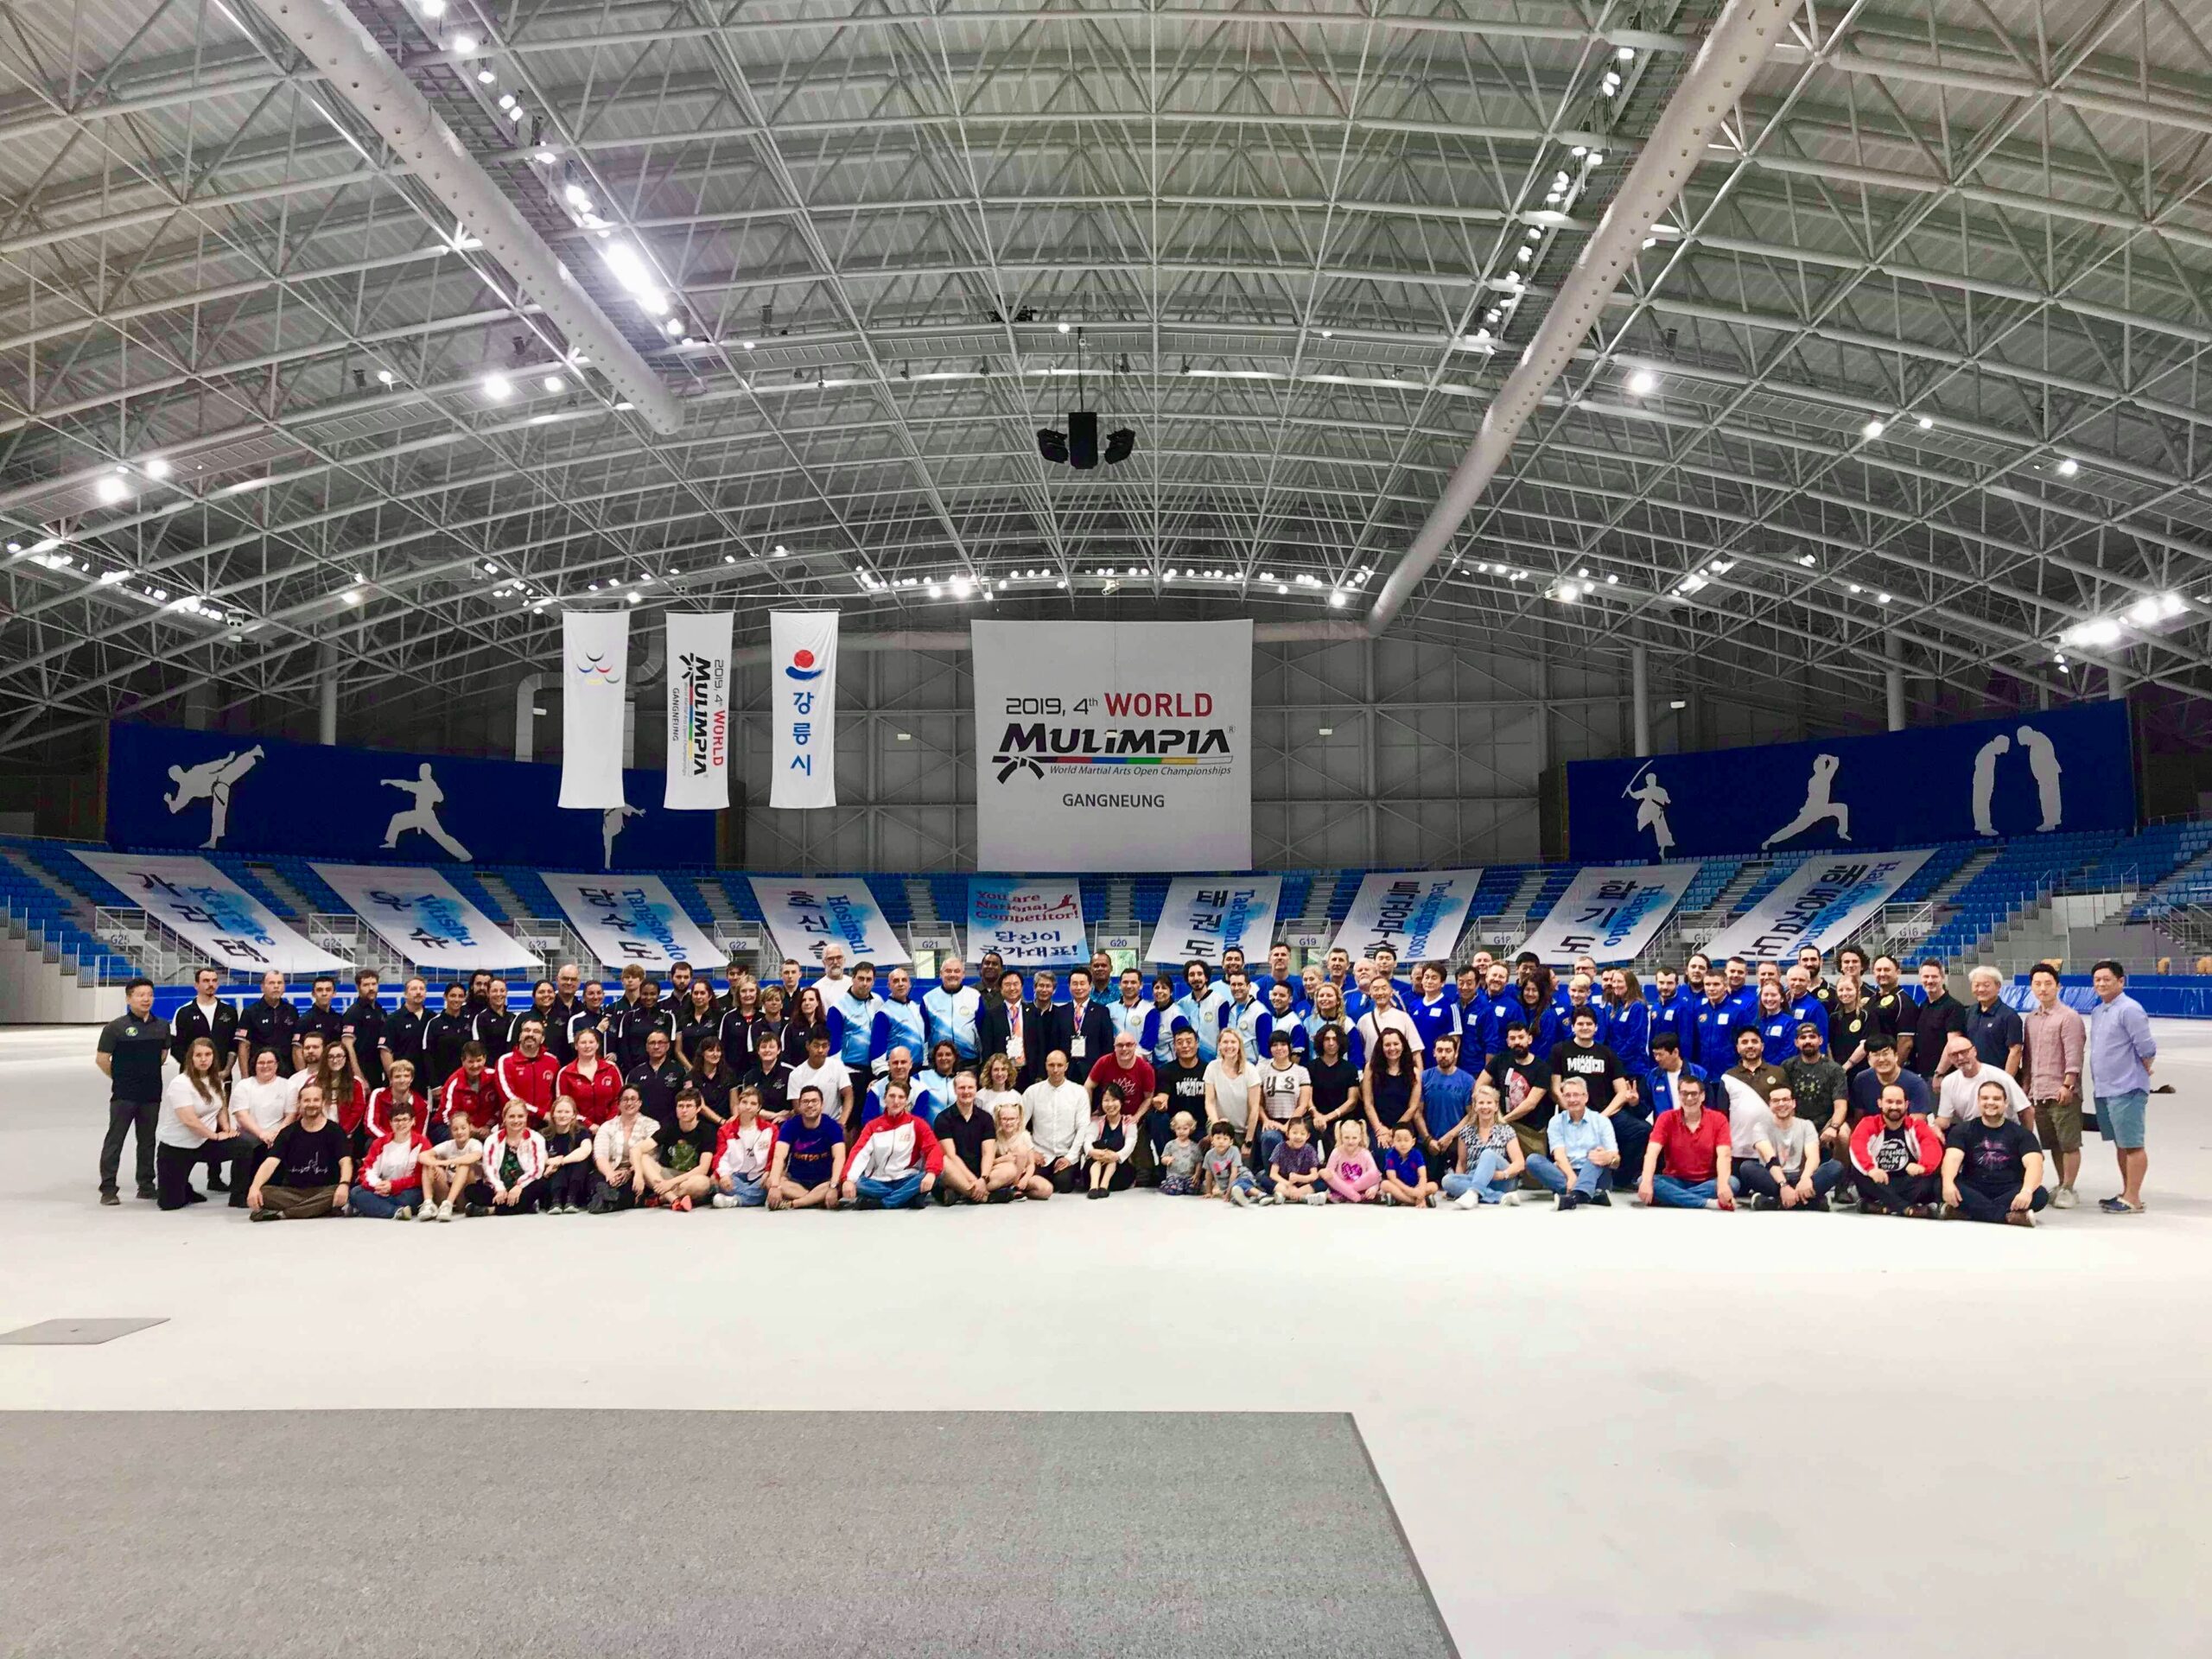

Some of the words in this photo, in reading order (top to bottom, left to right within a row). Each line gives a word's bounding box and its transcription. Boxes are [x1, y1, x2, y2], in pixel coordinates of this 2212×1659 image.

[714, 659, 724, 690] 2019,
[671, 688, 680, 741] GANGNEUNG
[694, 657, 711, 775] MULIMPIA
[1006, 698, 1066, 717] 2019,
[1073, 697, 1098, 715] 4th
[1104, 692, 1213, 717] WORLD
[713, 709, 725, 766] WORLD
[1050, 766, 1076, 775] World
[1078, 766, 1111, 776] Martial
[1113, 766, 1132, 776] Arts
[1134, 766, 1158, 777] Open
[1160, 766, 1231, 777] Championships
[1063, 793, 1165, 808] GANGNEUNG
[976, 891, 1007, 900] You
[1012, 894, 1041, 903] are
[976, 900, 1048, 912] National
[976, 911, 1079, 923] Competitor!
[1551, 880, 1638, 954] 합기도
[369, 891, 449, 950] 우슈
[414, 893, 479, 948] Wushu
[577, 887, 663, 960] 당수도
[621, 887, 688, 961] Tangsoodo
[827, 894, 875, 955] Hosinsul
[995, 931, 1060, 944] 당신이
[1179, 890, 1229, 957] 태권도
[1223, 889, 1255, 950] Taekwond
[729, 941, 747, 950] G22
[922, 940, 938, 949] G21
[1299, 938, 1317, 946] G19
